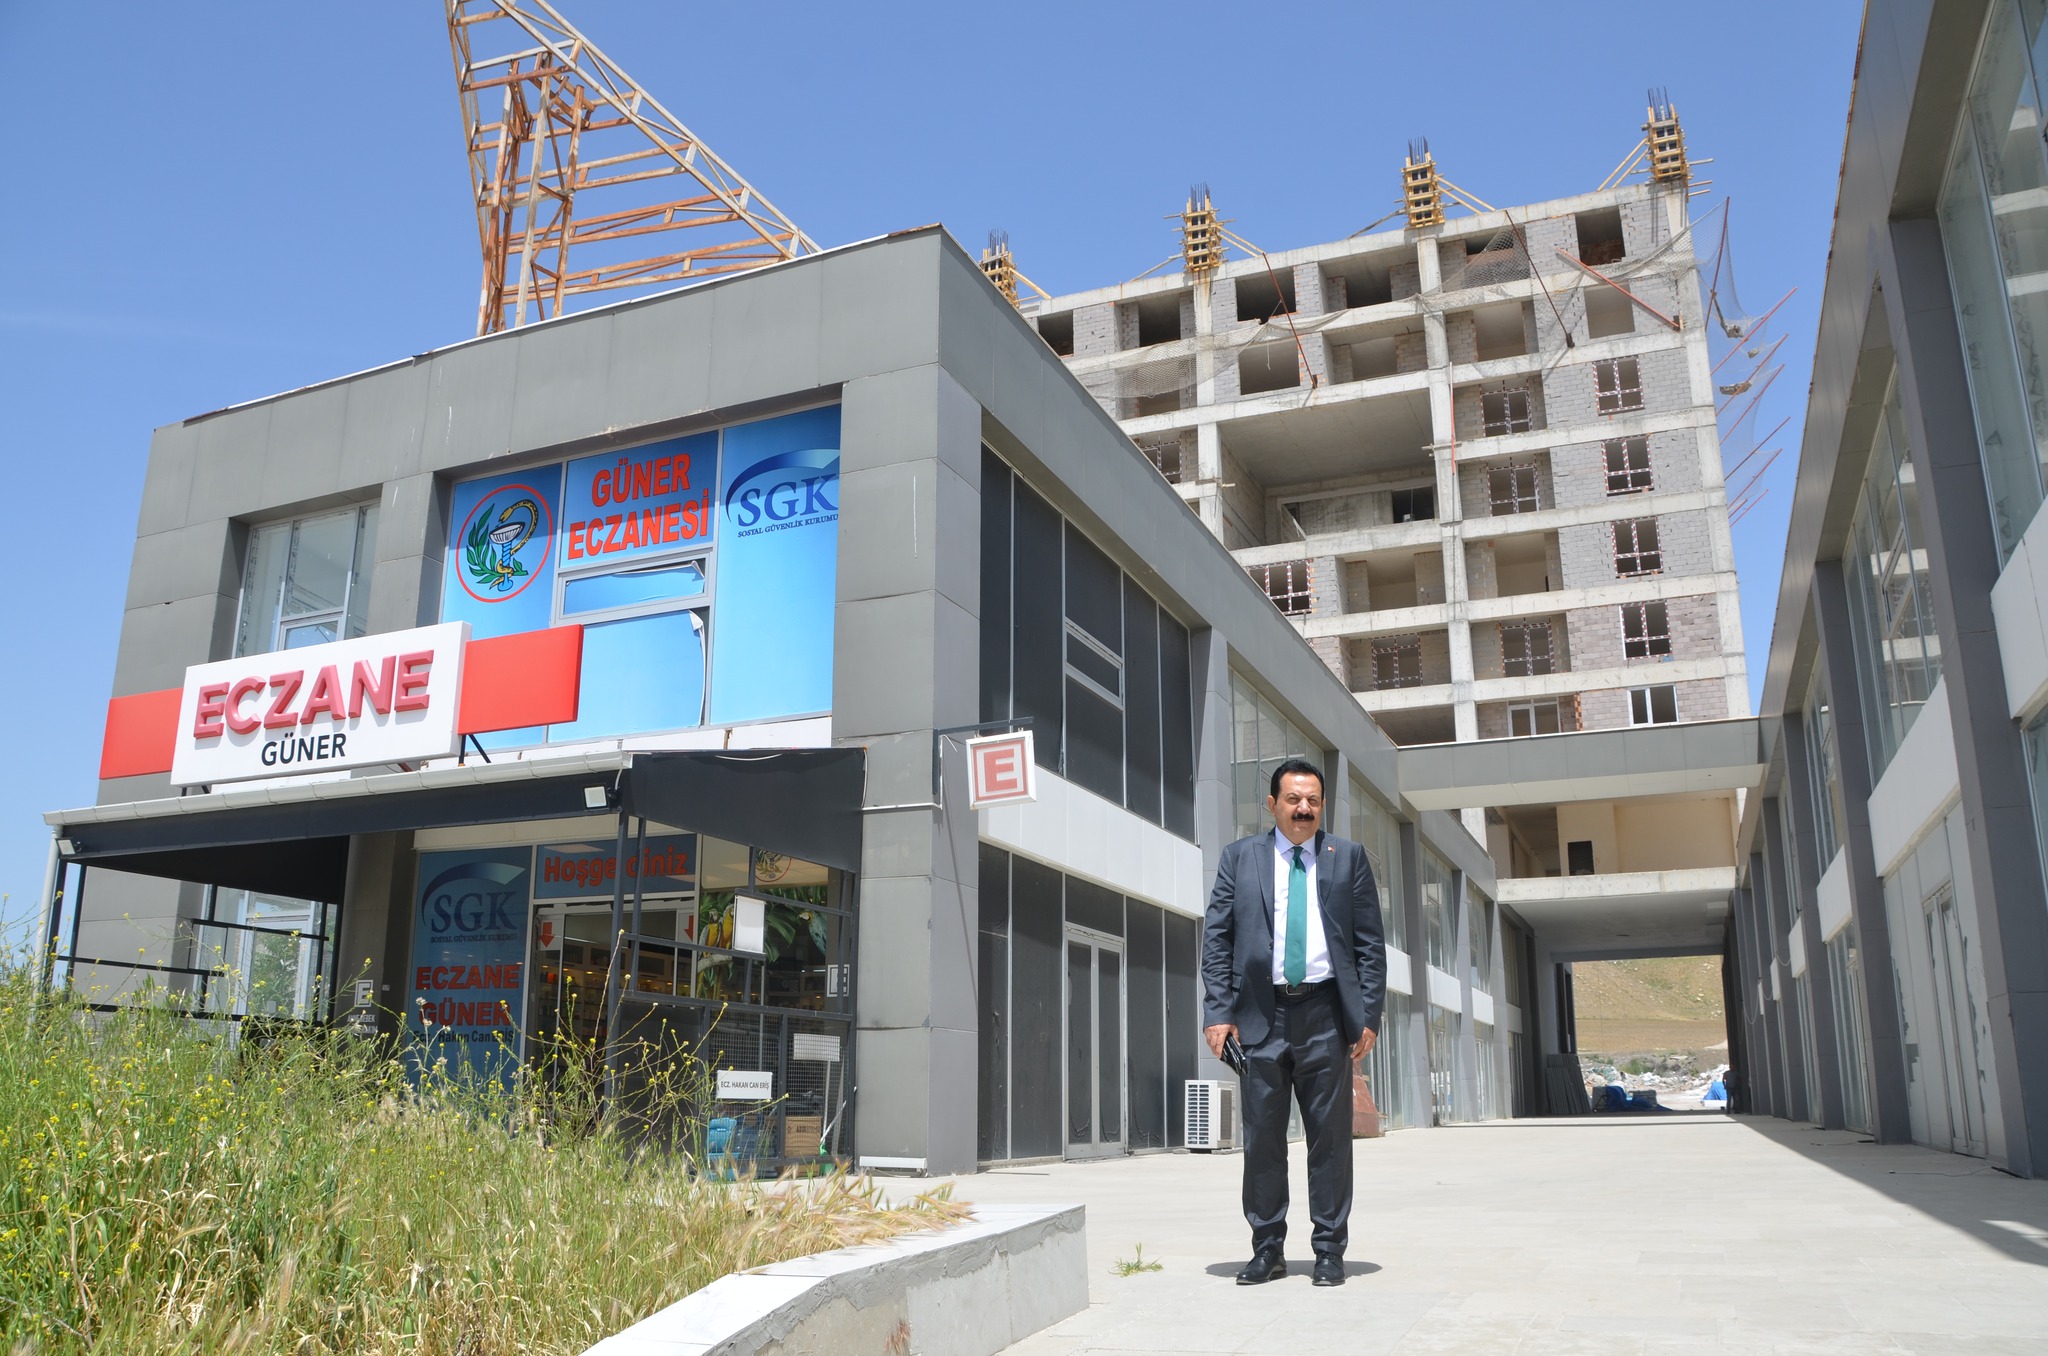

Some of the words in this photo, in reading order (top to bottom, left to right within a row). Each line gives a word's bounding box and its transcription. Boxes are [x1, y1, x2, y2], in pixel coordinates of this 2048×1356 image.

[591, 453, 691, 507] GÜNER
[738, 474, 838, 527] SGK
[568, 488, 710, 560] ECZANESİ
[738, 528, 763, 538] SOSYAL
[765, 520, 803, 533] GÜVENLİK
[804, 514, 838, 526] KURUMU
[194, 649, 434, 739] ECZANE
[261, 732, 347, 766] GÜNER
[984, 748, 1018, 793] E
[431, 891, 517, 933] SGK
[415, 964, 520, 990] ECZANE
[419, 997, 511, 1026] GÜNER
[471, 1030, 491, 1042] Can
